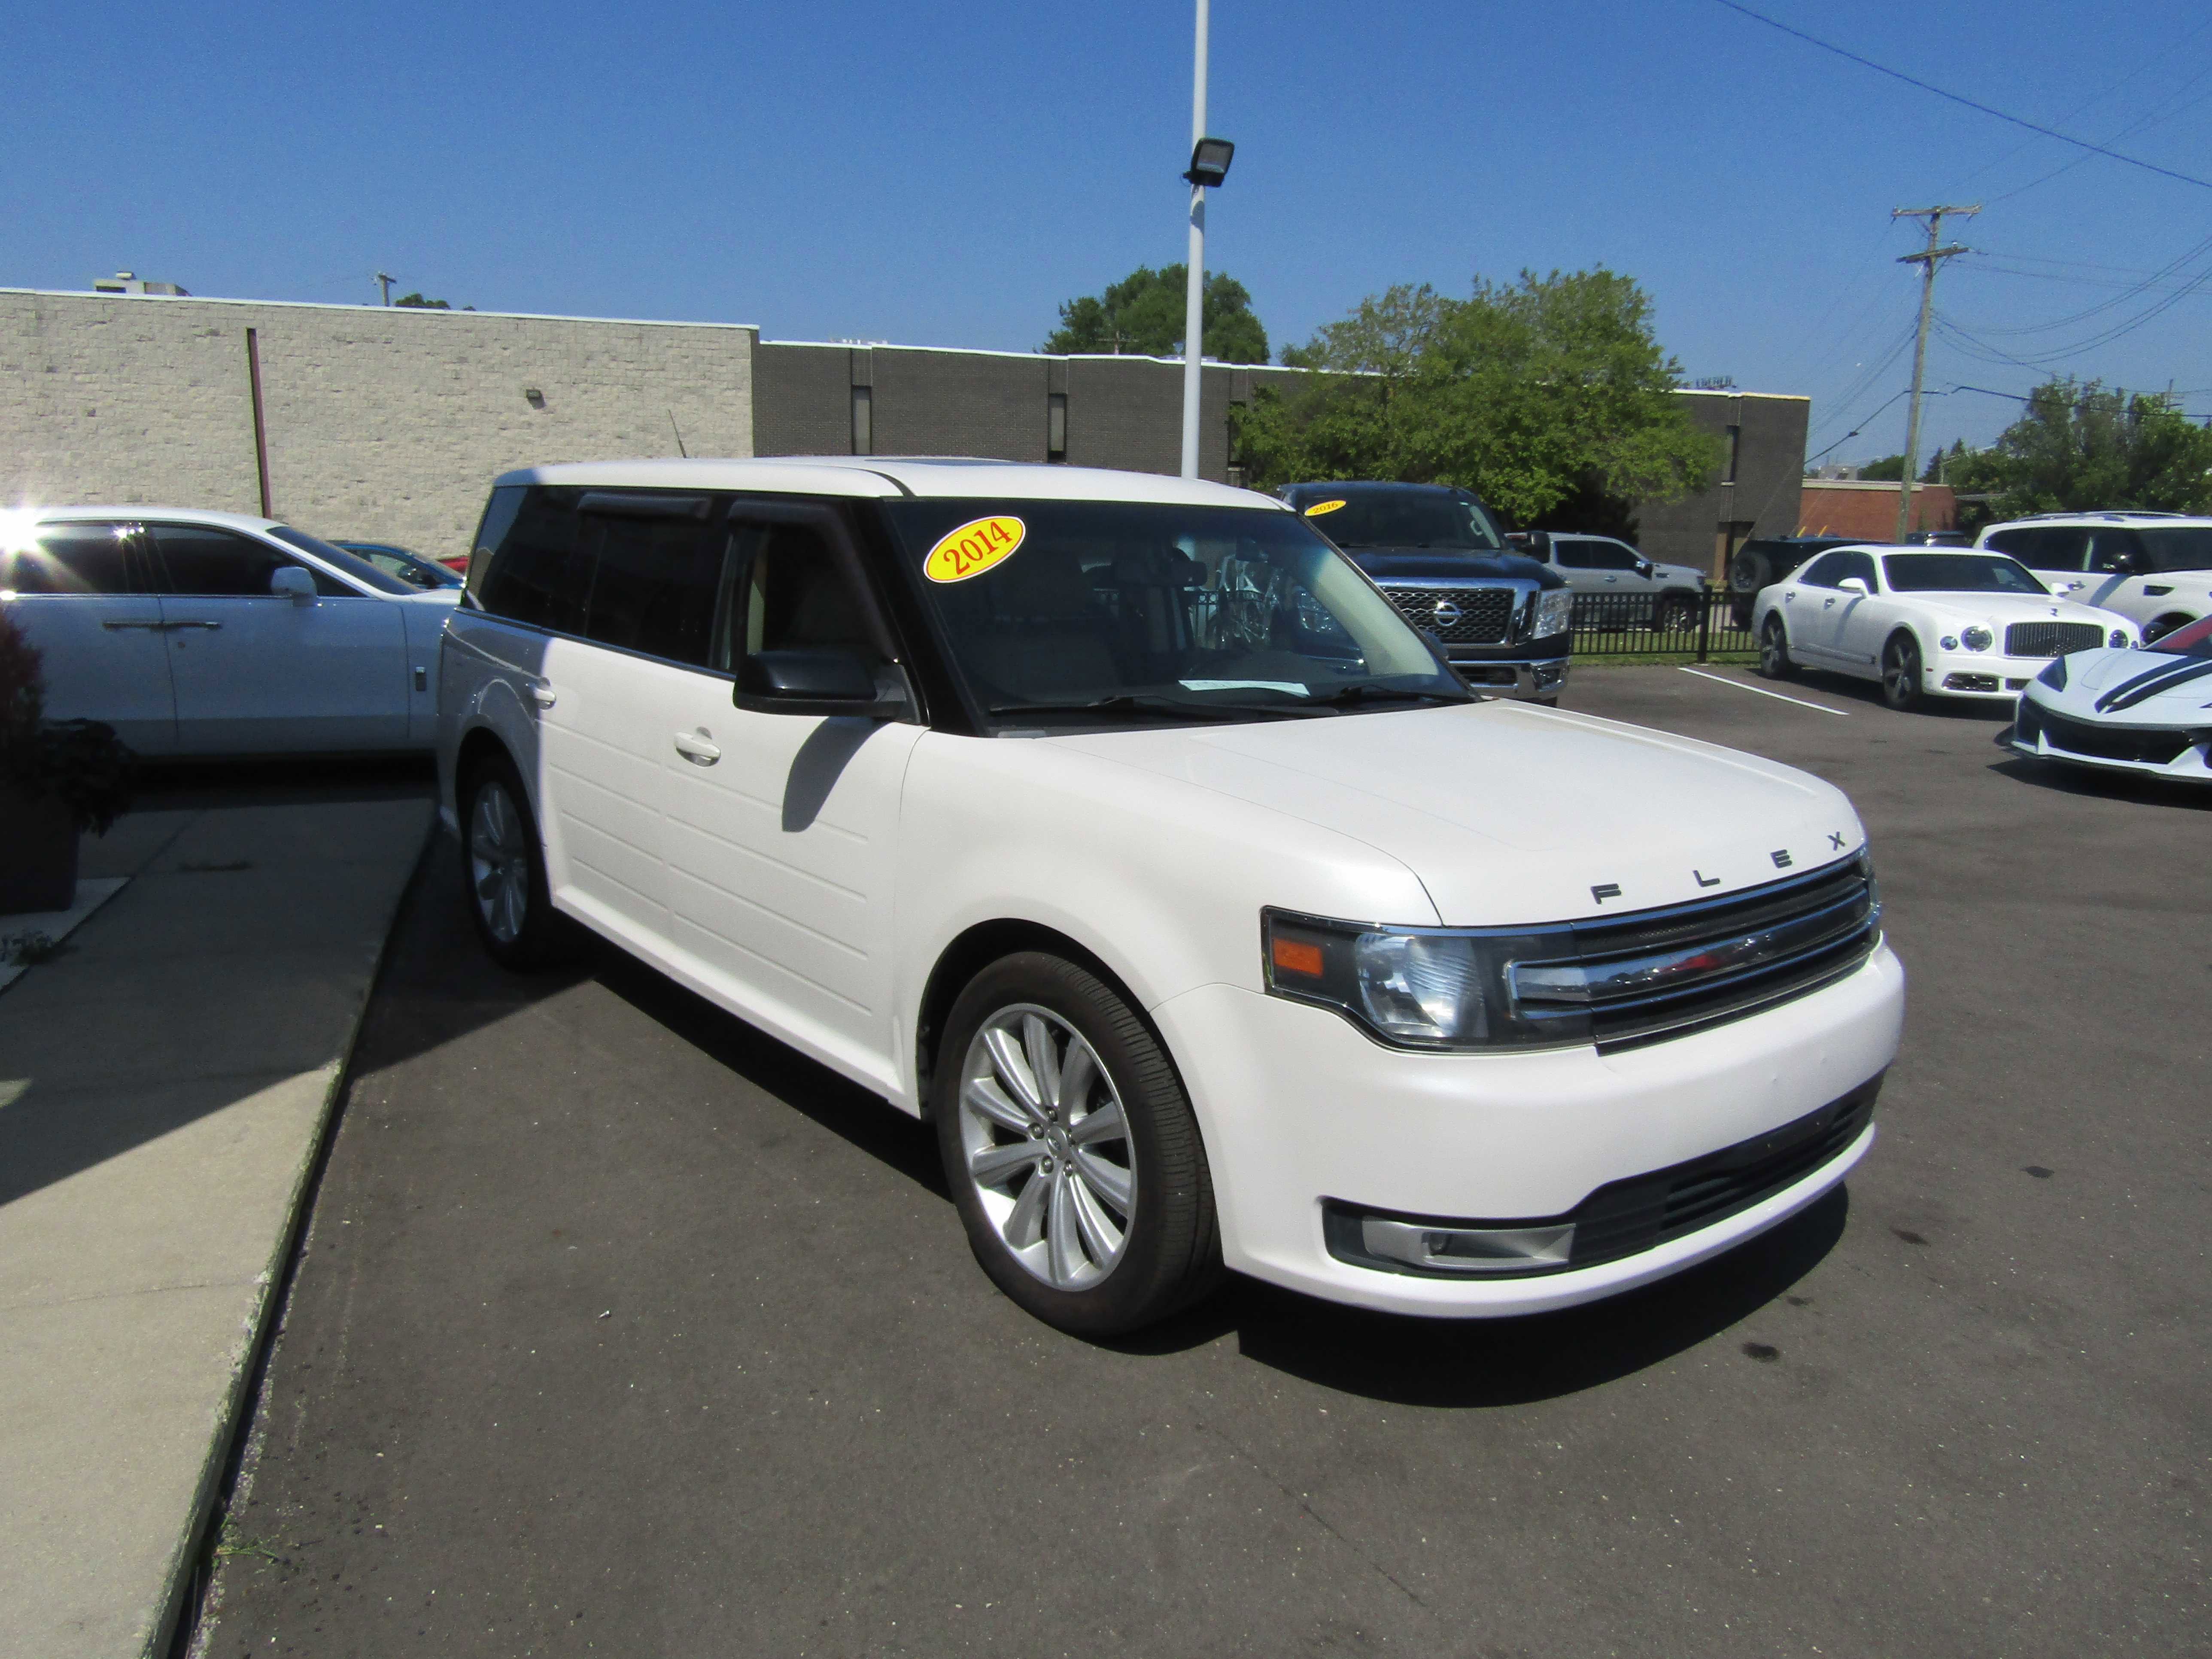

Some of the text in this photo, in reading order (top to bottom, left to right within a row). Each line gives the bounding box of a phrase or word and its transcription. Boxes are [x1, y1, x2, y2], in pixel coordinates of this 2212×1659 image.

[1313, 502, 1338, 514] 2016
[944, 522, 1012, 574] 2014
[1590, 831, 1845, 904] FLEX
